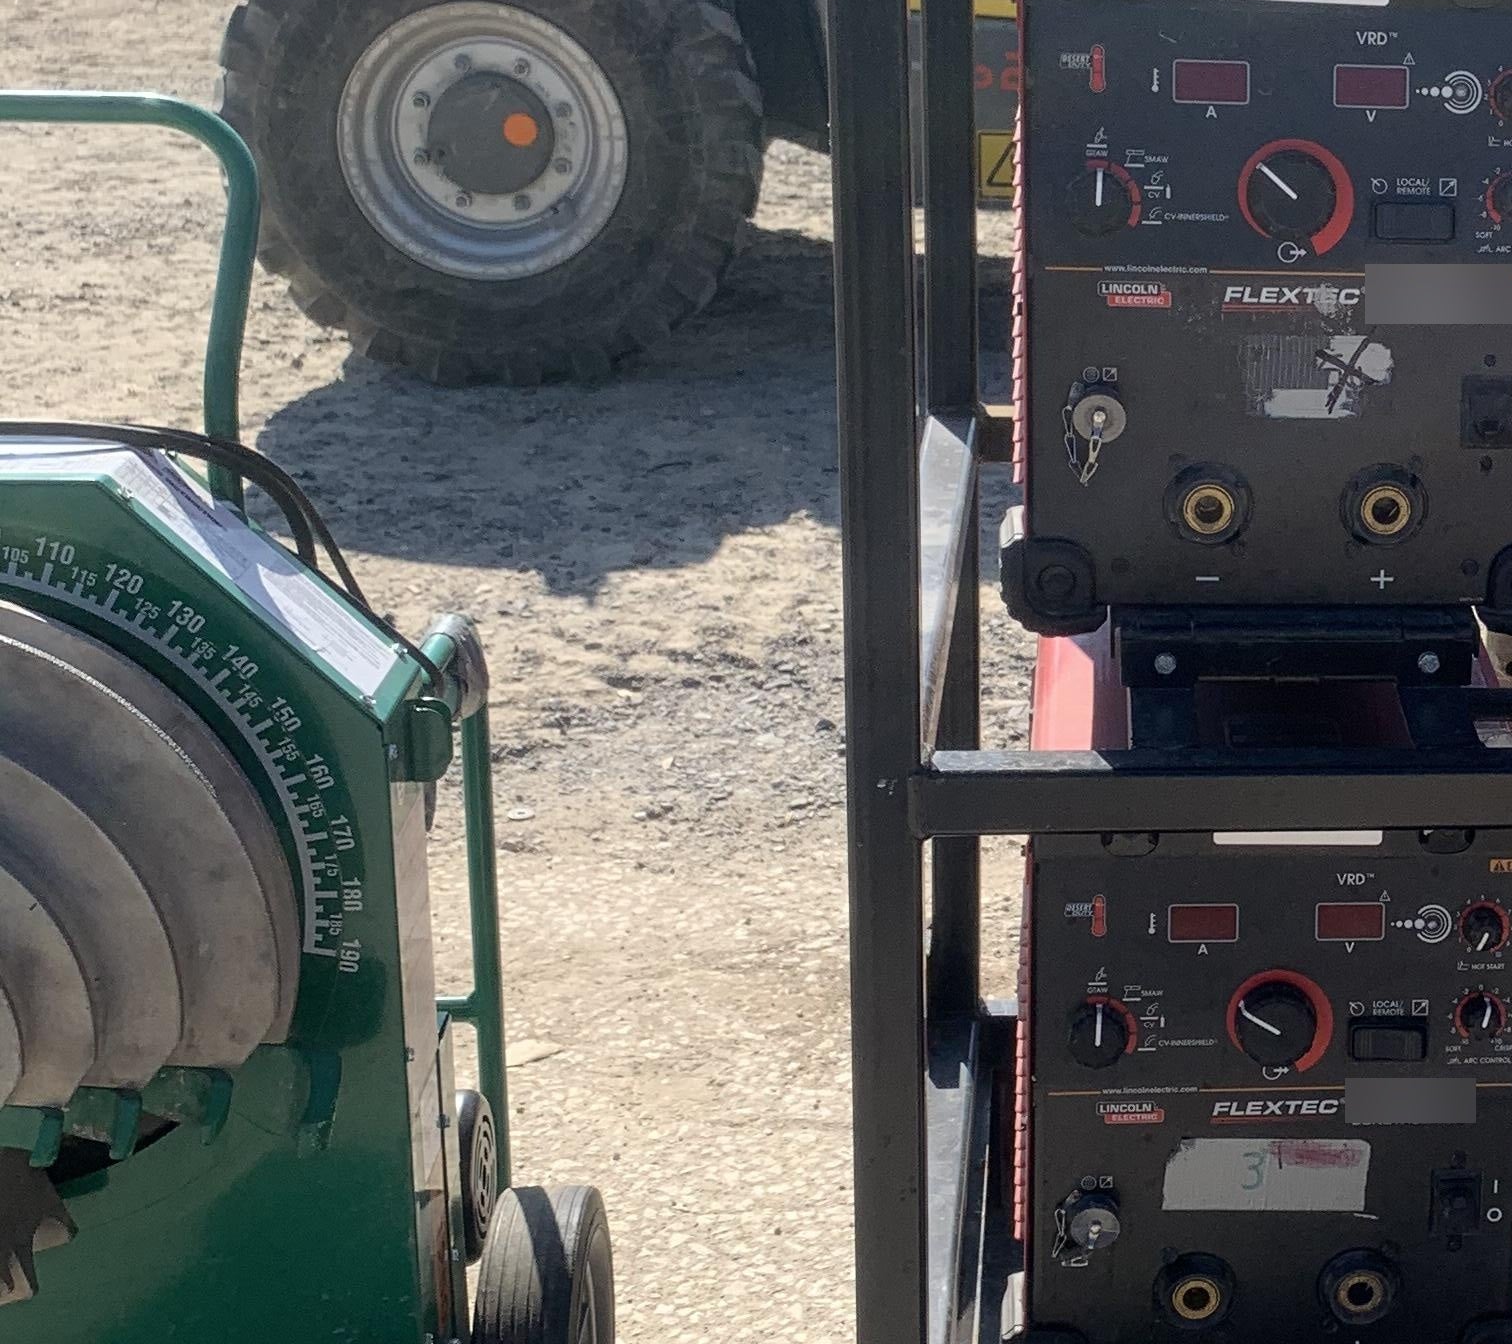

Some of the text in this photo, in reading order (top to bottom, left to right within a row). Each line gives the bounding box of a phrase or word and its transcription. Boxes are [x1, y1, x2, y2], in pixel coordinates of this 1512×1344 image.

[1205, 105, 1218, 119] A
[1366, 110, 1377, 123] V
[1148, 191, 1160, 199] CV
[1104, 264, 1208, 274] www.lincolnelectric.com
[1102, 283, 1158, 295] LINCOLN
[1115, 296, 1164, 306] ELECTRIC
[1, 545, 30, 565] 105
[34, 537, 77, 566] 110
[70, 565, 98, 587] 115
[103, 563, 146, 595] 120
[133, 596, 162, 620] 125
[166, 598, 207, 634] 130
[220, 643, 258, 680] 140
[237, 681, 265, 709] 145
[270, 696, 302, 733] 150
[277, 736, 302, 762] 155
[304, 753, 336, 791] 160
[305, 793, 326, 819] 165
[330, 814, 356, 852] 170
[323, 854, 340, 878] 175
[342, 876, 364, 913] 180
[328, 912, 344, 936] 185
[338, 938, 362, 974] 190
[1197, 944, 1209, 955] A
[1345, 942, 1355, 953] V
[1102, 1086, 1198, 1095] www.lincolnelectric.com
[1099, 1103, 1152, 1114] LINCOLN
[1111, 1114, 1158, 1122] ELECTRIC
[1212, 1099, 1340, 1116] FLEXTEC
[1241, 1151, 1265, 1190] 3
